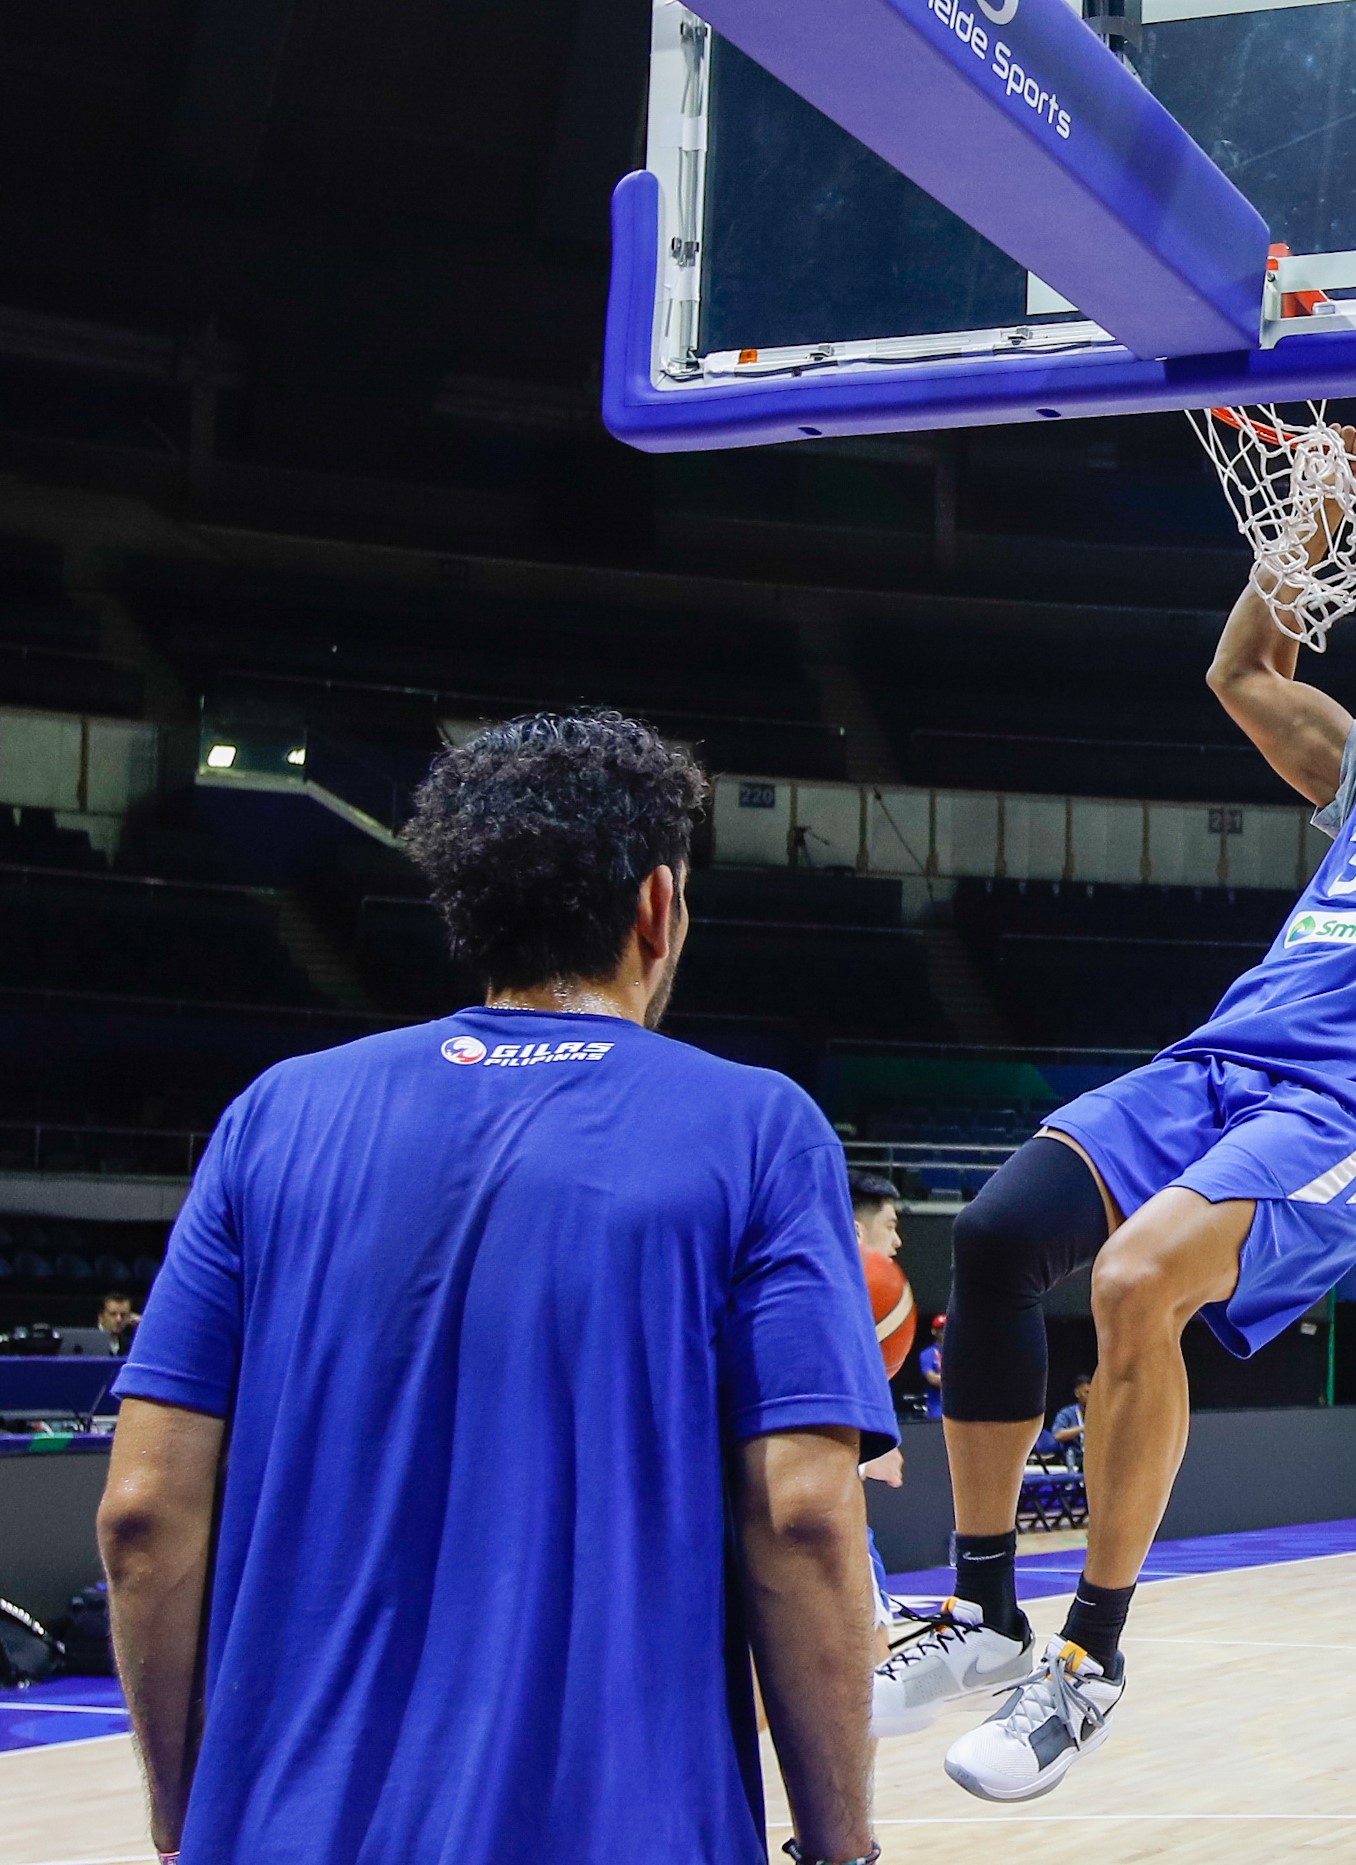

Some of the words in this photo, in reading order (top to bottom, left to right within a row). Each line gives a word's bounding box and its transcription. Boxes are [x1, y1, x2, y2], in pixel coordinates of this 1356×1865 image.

[928, 0, 989, 60] elde
[992, 41, 1072, 139] Sports
[489, 1041, 616, 1059] GILAS
[483, 1052, 606, 1067] PILIPINAS
